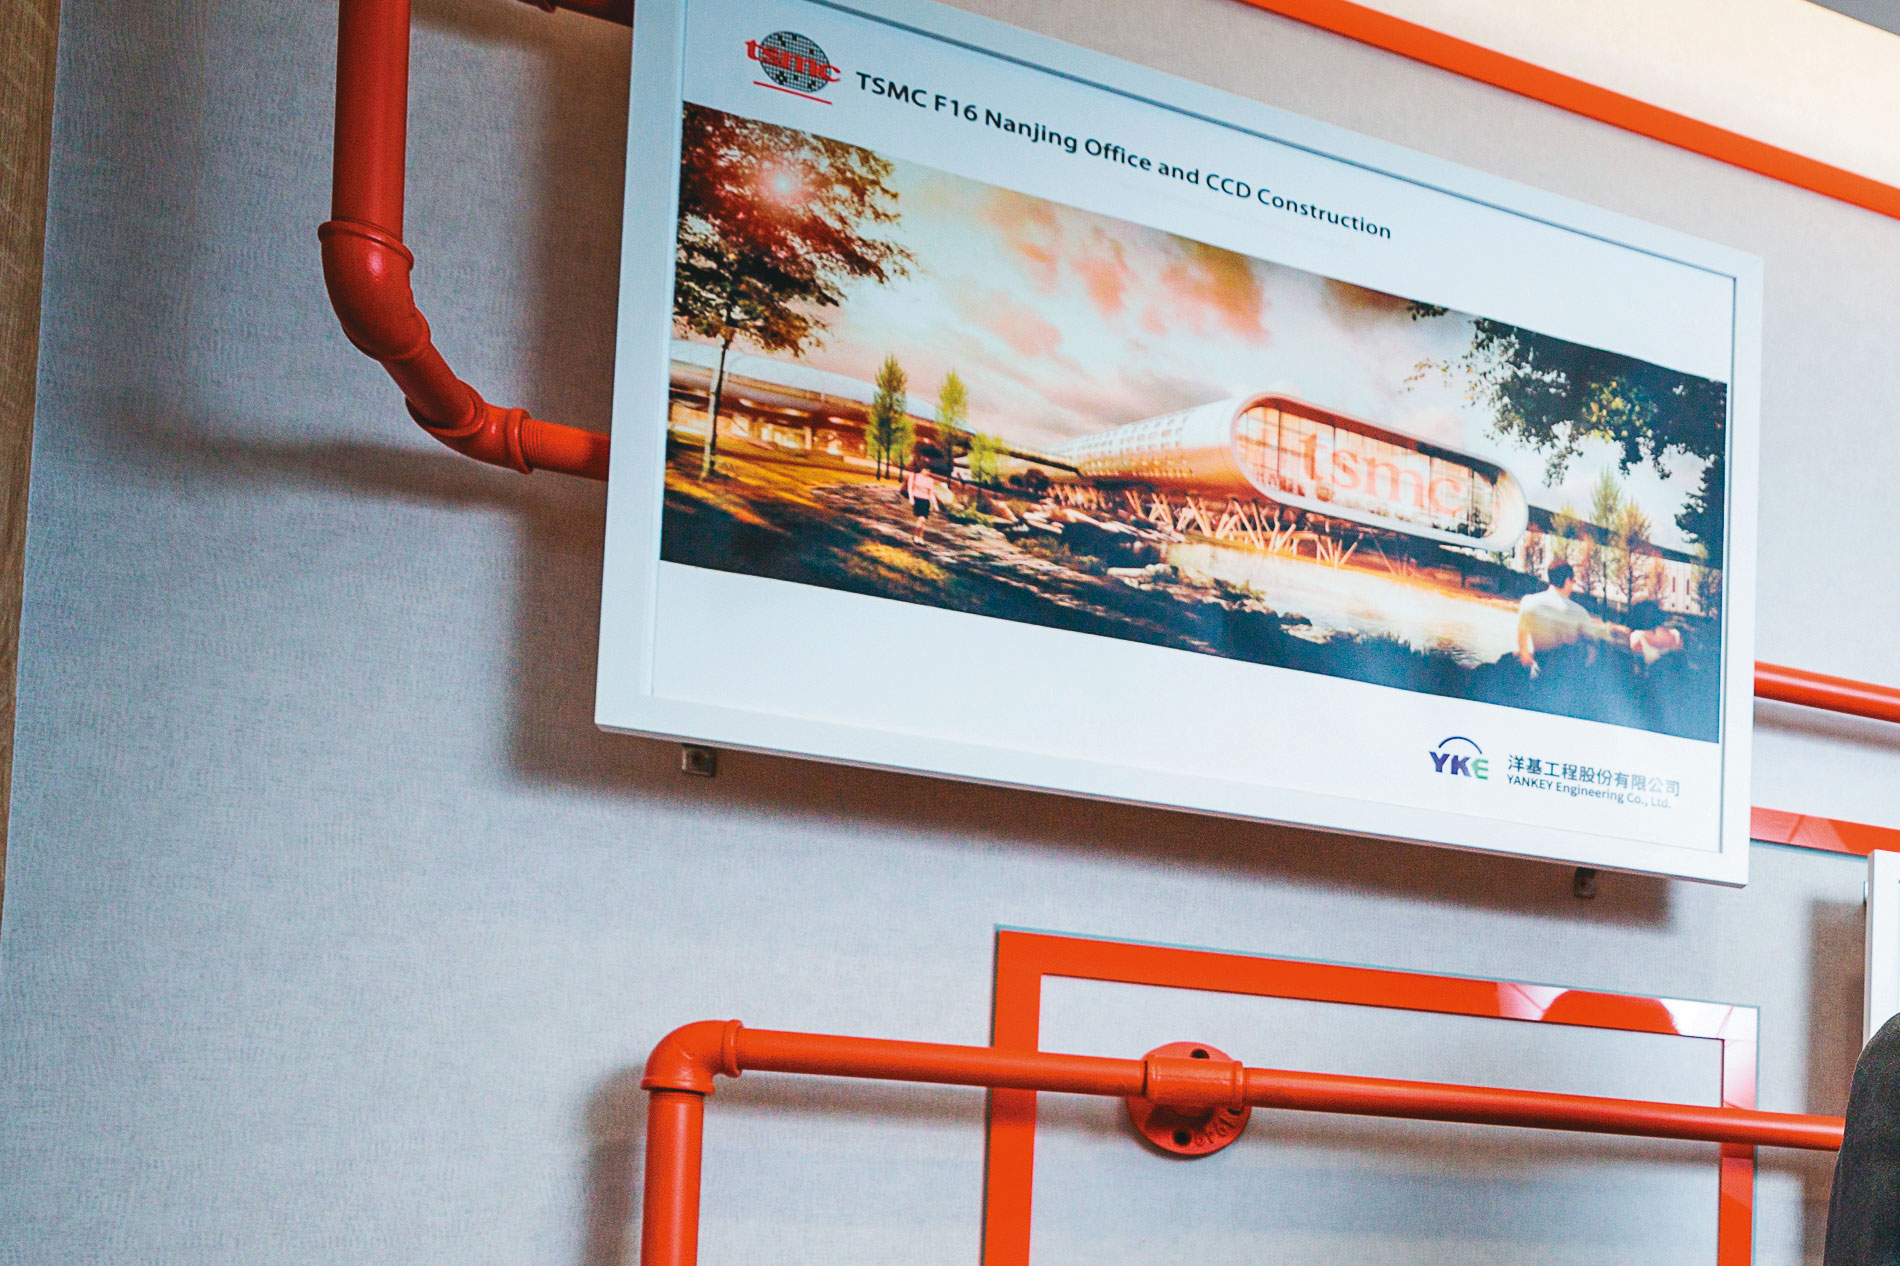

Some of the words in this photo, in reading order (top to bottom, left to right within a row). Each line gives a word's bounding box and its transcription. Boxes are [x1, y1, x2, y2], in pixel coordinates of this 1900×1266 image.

[744, 39, 841, 83] tsmc
[856, 71, 928, 108] TSMC
[935, 94, 978, 122] F16
[985, 108, 1078, 154] Nanjing
[1084, 138, 1152, 171] Office
[1157, 162, 1200, 185] and
[1206, 173, 1252, 199] CCD
[1257, 188, 1392, 240] Construction
[1299, 432, 1464, 517] tsmc
[1428, 750, 1490, 781] YKE
[1507, 754, 1681, 797] 洋基工程股份有限公司
[1506, 773, 1554, 791] YANKEY
[1556, 781, 1625, 805] Engineering
[1650, 797, 1672, 809] Ltd.
